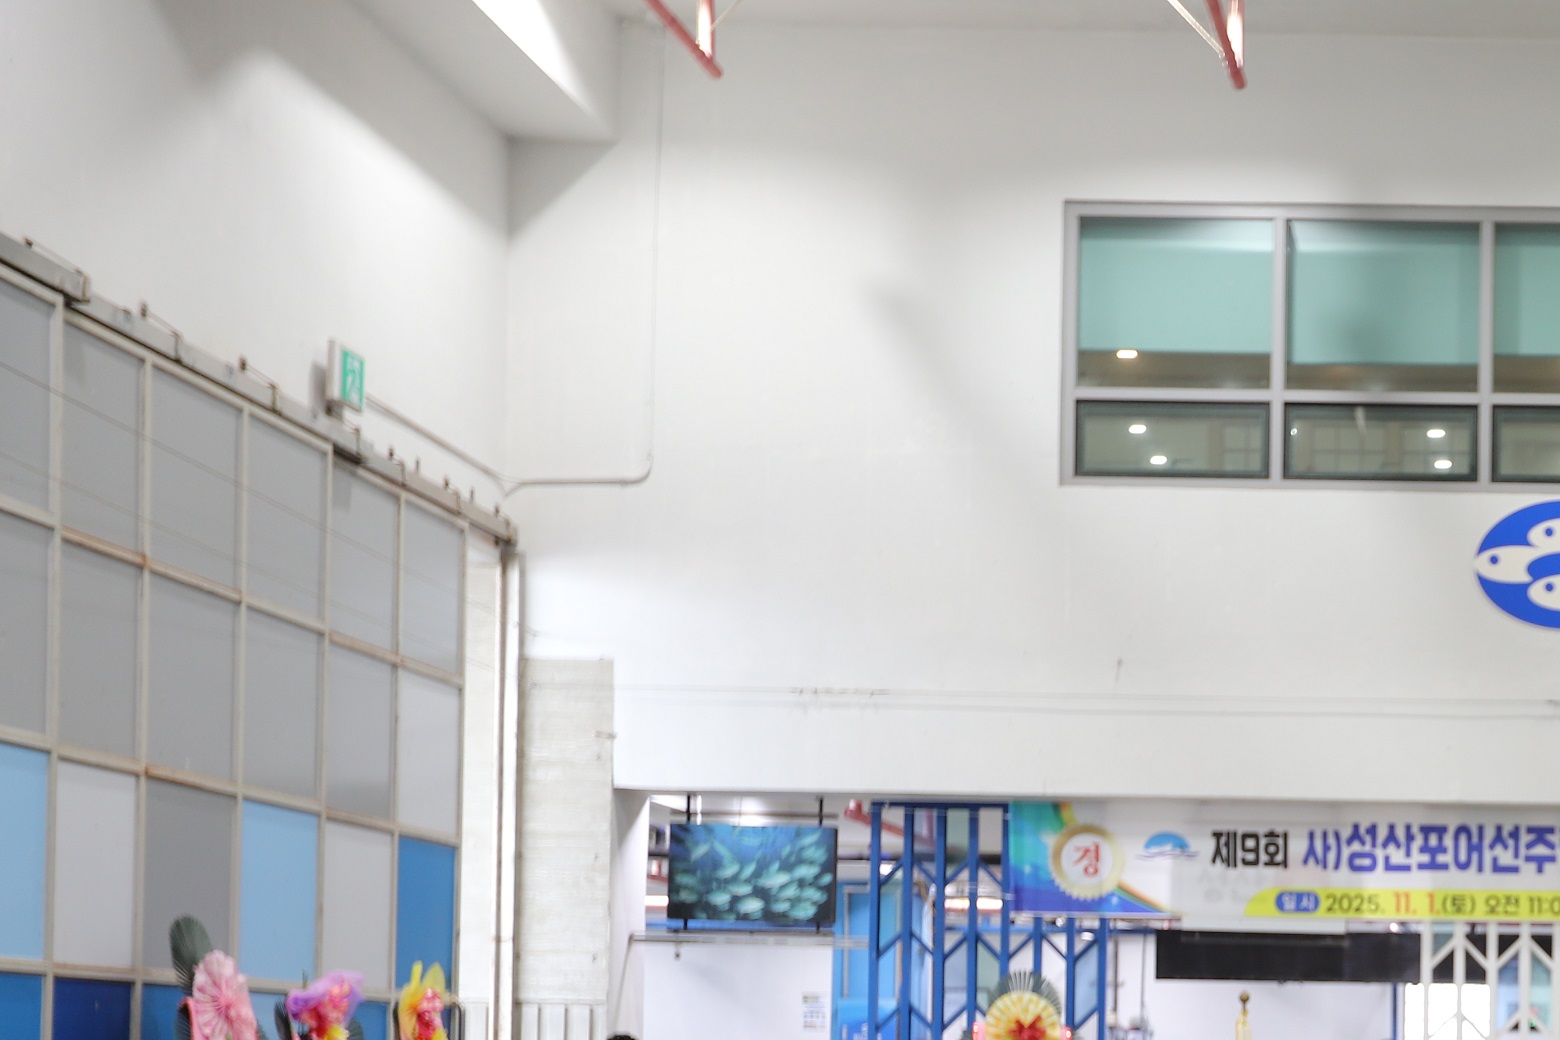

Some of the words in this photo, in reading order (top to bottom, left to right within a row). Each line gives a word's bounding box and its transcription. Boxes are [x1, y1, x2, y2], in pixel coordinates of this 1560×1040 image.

[1074, 843, 1100, 877] 경
[1211, 829, 1289, 868] 제9회
[1325, 894, 1386, 914] 2025.
[1484, 893, 1520, 915] 오전
